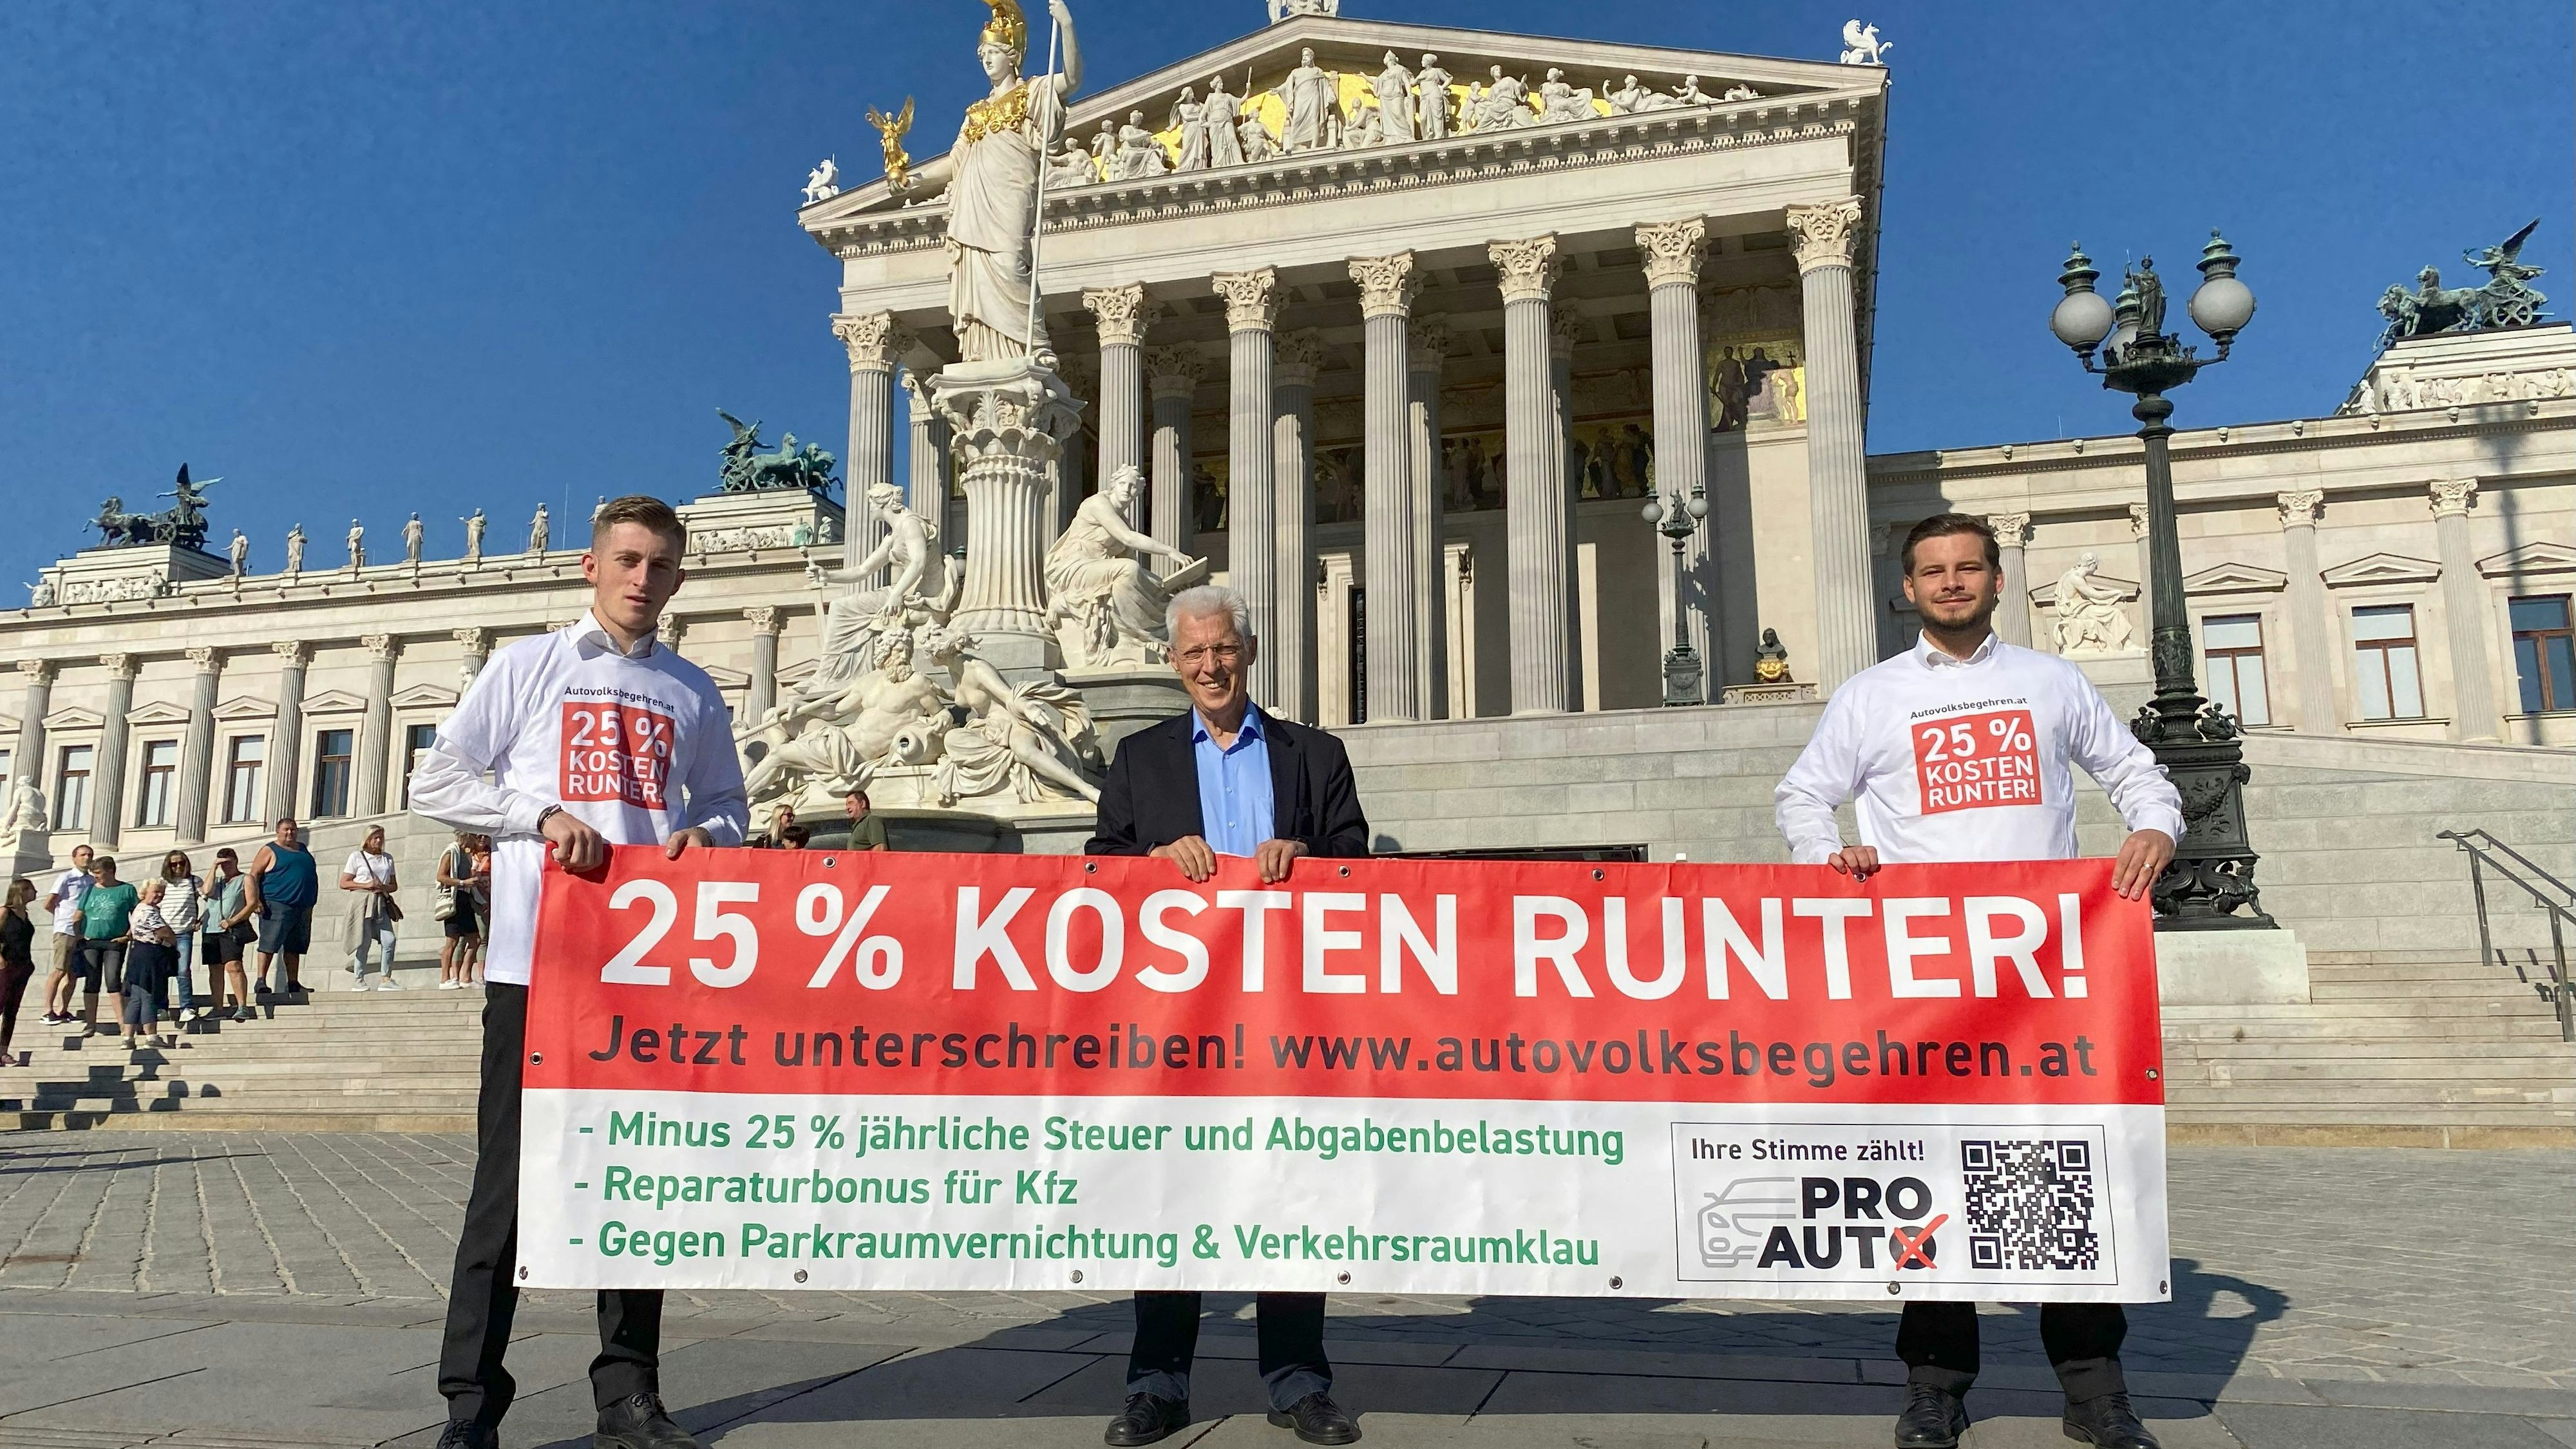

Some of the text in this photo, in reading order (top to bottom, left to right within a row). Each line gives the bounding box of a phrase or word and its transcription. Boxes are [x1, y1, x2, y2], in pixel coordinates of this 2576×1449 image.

[564, 686, 675, 713] Autovolksbegehren.at
[1910, 697, 2028, 719] Autovolksbegehren.at
[570, 710, 667, 757] 25 %
[1921, 717, 2032, 762] 25 %
[569, 750, 665, 782] KOSTEN
[1925, 755, 2034, 787] KOSTEN
[568, 774, 663, 803] RUNTER!
[1928, 778, 2036, 808] RUNTER!
[600, 878, 2088, 1000] 25 % KOSTEN RUNTER!
[589, 1015, 2098, 1088] Jetzt unterschreiben! www.autovolksbegehren.at
[609, 1112, 730, 1148] Minus
[746, 1115, 795, 1149] 25
[811, 1116, 844, 1150] %
[855, 1117, 1029, 1158] jährliche
[1045, 1116, 1171, 1151] Steuer
[1185, 1117, 1252, 1151] und
[1265, 1117, 1624, 1166] Abgabenbelastung
[1692, 1138, 1924, 1161] Ihre Stimme zählt!
[604, 1166, 929, 1209] Reparaturbonus
[944, 1170, 1001, 1204] für
[1016, 1171, 1077, 1204] Kfz
[1801, 1177, 1933, 1220] PRO
[599, 1221, 724, 1266] Gegen
[741, 1223, 1178, 1267] Parkraumvernichtung
[1192, 1224, 1220, 1260] &
[1234, 1225, 1598, 1265] Verkehrsraumklau
[1757, 1226, 1937, 1270] AUTO
